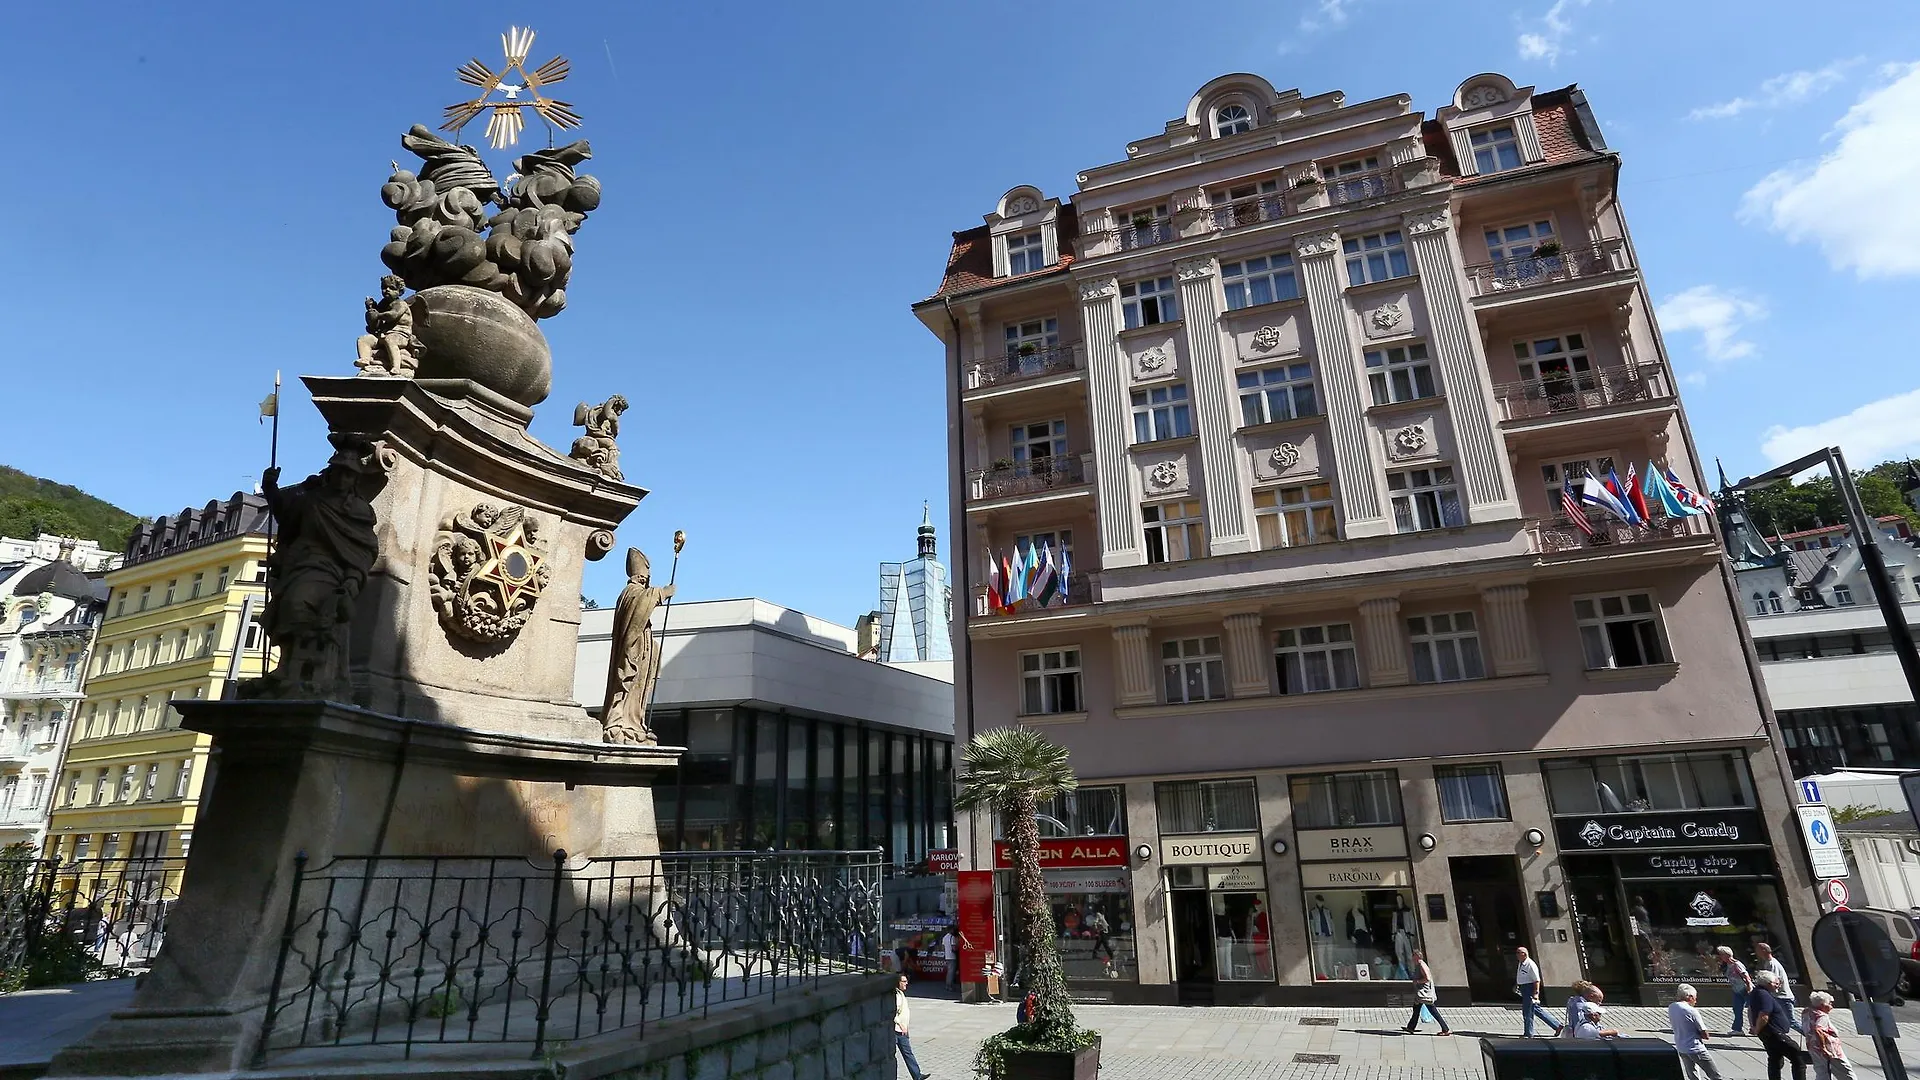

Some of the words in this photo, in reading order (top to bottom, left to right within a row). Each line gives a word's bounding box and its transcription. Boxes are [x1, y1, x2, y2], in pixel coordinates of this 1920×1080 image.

[1608, 825, 1676, 843] Captain
[1681, 822, 1739, 840] Candy
[1330, 837, 1373, 848] BRAX
[1002, 848, 1063, 860] SON
[1071, 846, 1120, 859] ALLA
[1172, 843, 1251, 857] BOUTIQUE
[931, 853, 959, 861] KARLOV
[1650, 856, 1697, 869] Candy
[1704, 855, 1738, 868] shop
[940, 862, 959, 870] OPLA
[1329, 872, 1381, 883] BARONIA
